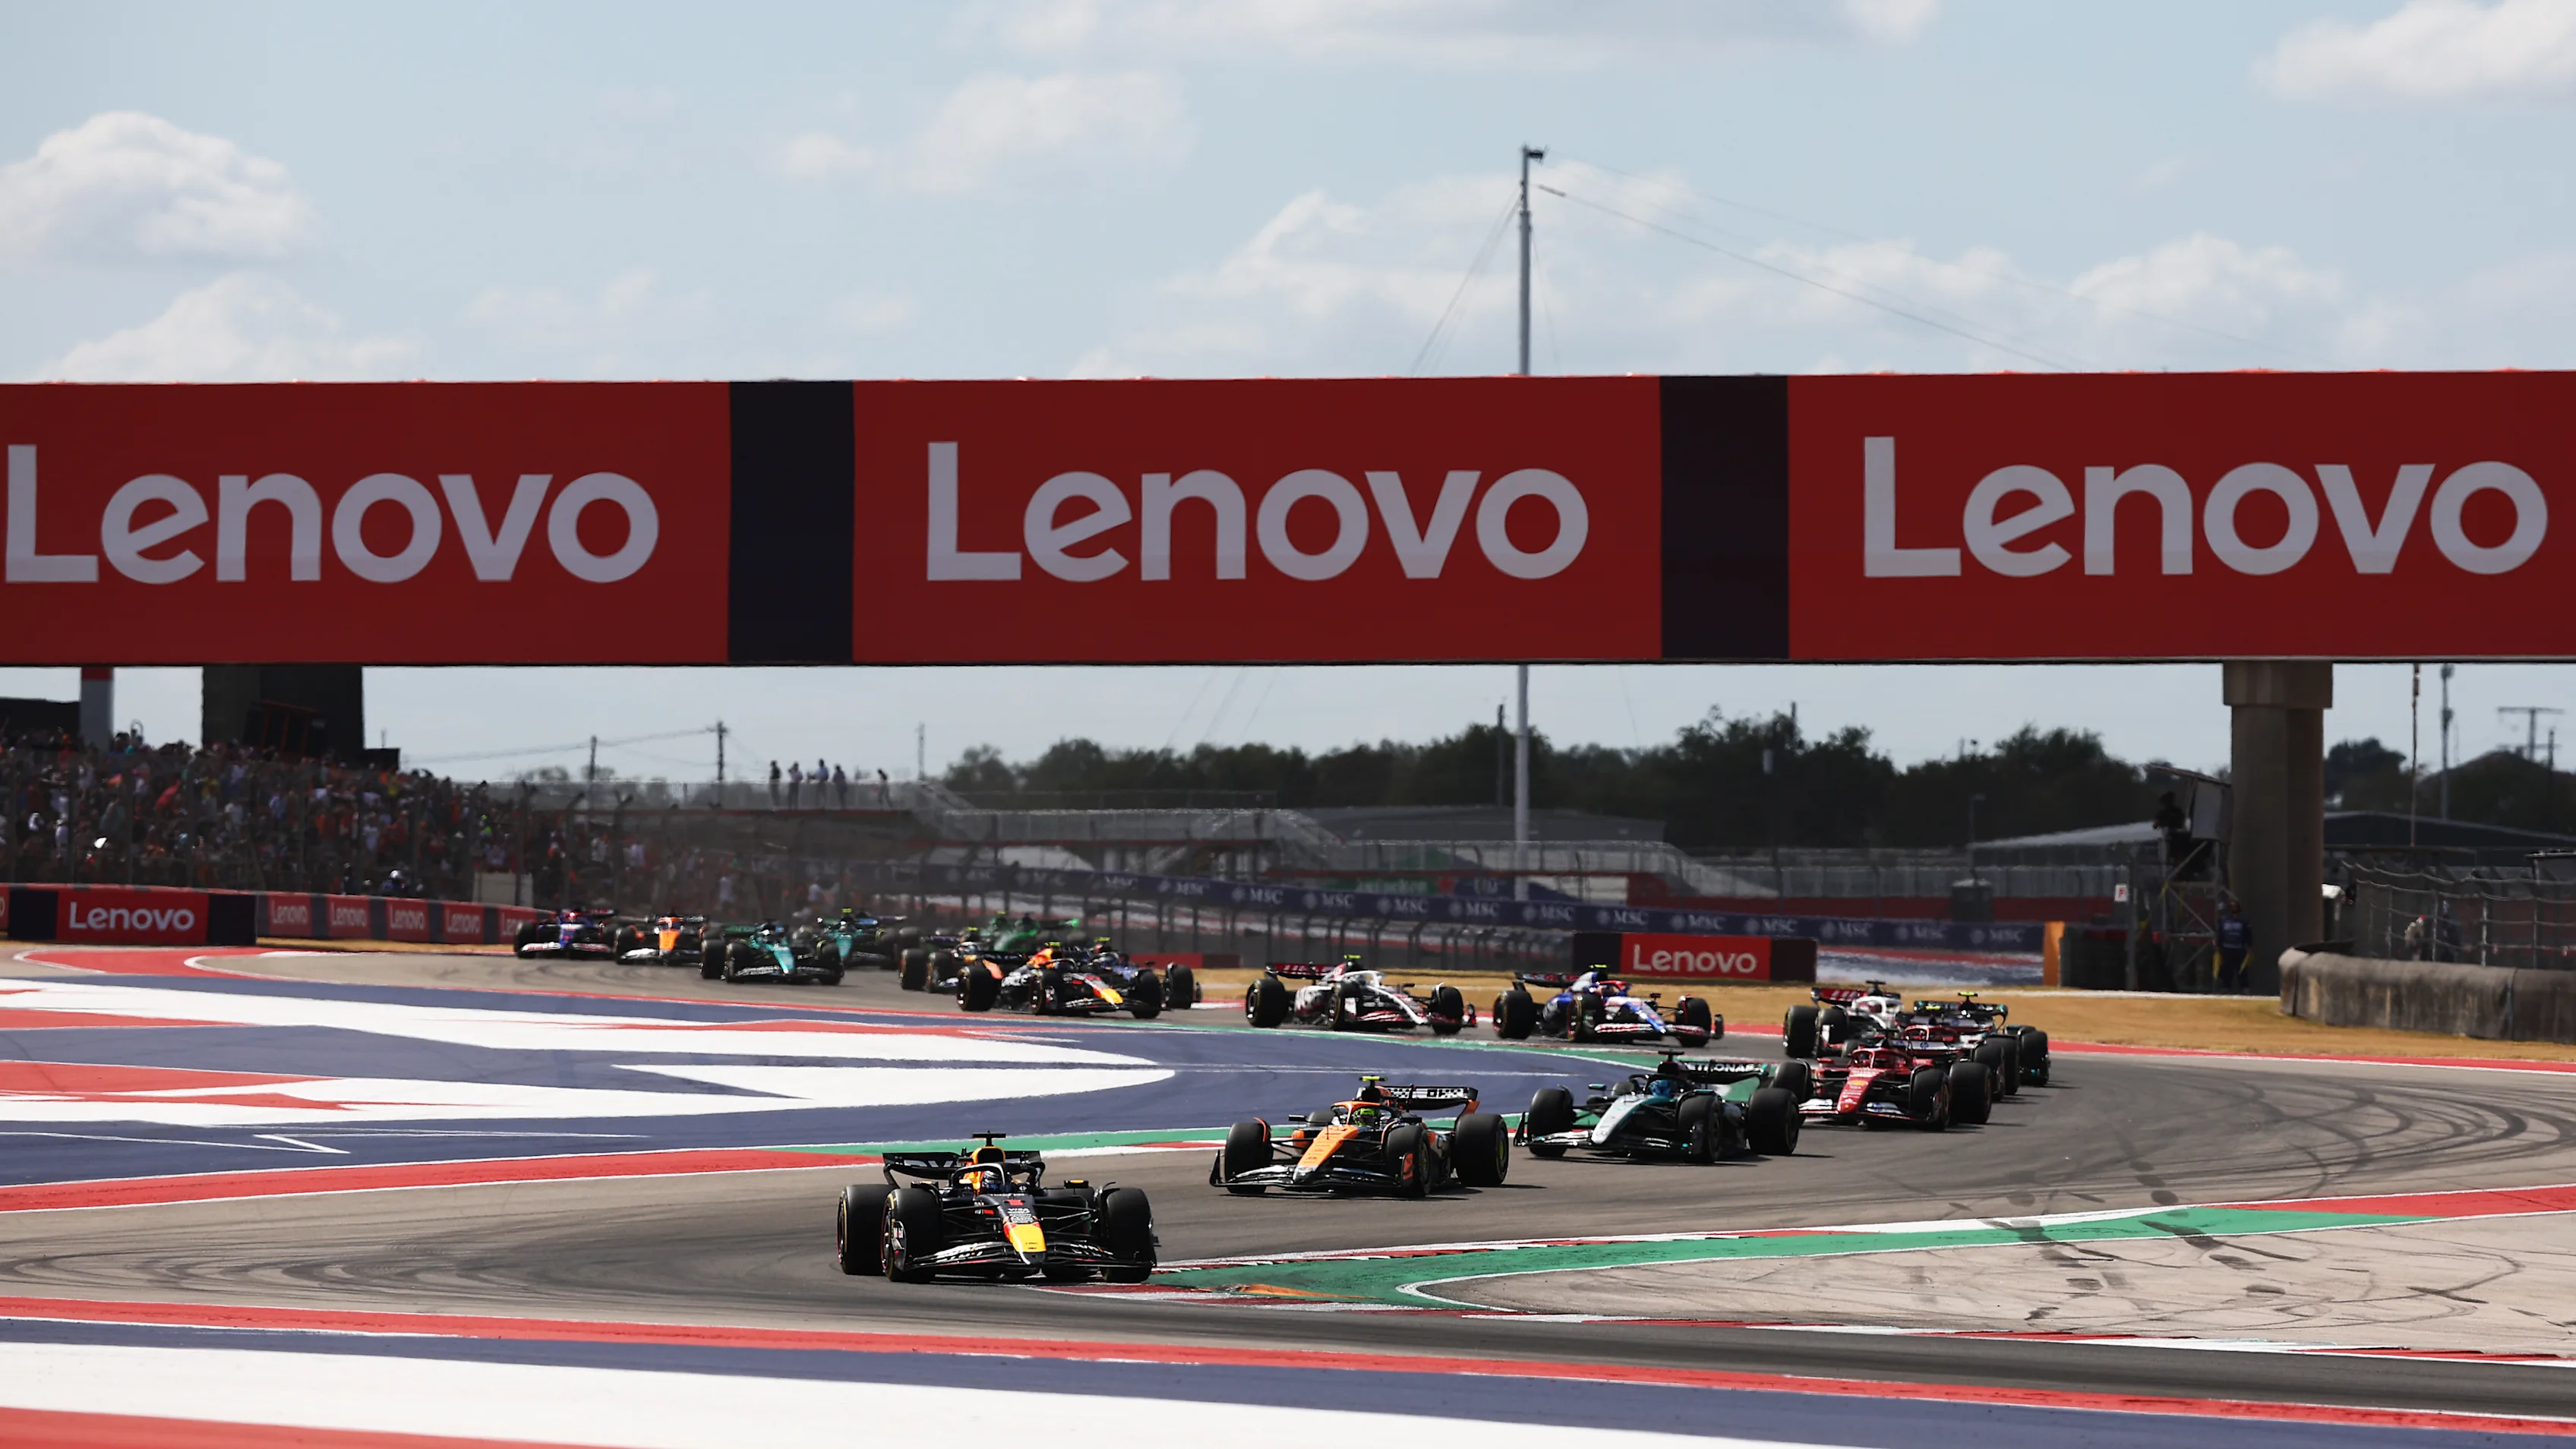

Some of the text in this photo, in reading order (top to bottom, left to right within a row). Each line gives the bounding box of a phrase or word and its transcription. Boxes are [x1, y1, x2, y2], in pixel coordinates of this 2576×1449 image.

[6, 444, 659, 583] Lenovo
[927, 441, 1589, 582] Lenovo
[1864, 436, 2548, 577] Lenovo
[1250, 888, 1283, 904] MSC
[1321, 892, 1355, 908] MSC
[271, 899, 308, 924] Lenovo
[1394, 896, 1428, 914] MSC
[1466, 901, 1499, 918] MSC
[1541, 905, 1574, 922] MSC
[69, 901, 194, 931] Lenovo
[330, 902, 368, 927] Lenovo
[389, 904, 425, 930] Lenovo
[445, 908, 481, 934] Lenovo
[1614, 909, 1648, 926] MSC
[1688, 914, 1725, 930] MSC
[1762, 918, 1798, 933] MSC
[1839, 921, 1874, 938] MSC
[1989, 928, 2025, 942] MSC
[1632, 943, 1757, 974] Lenovo
[1685, 1062, 1759, 1073] ETRONAS
